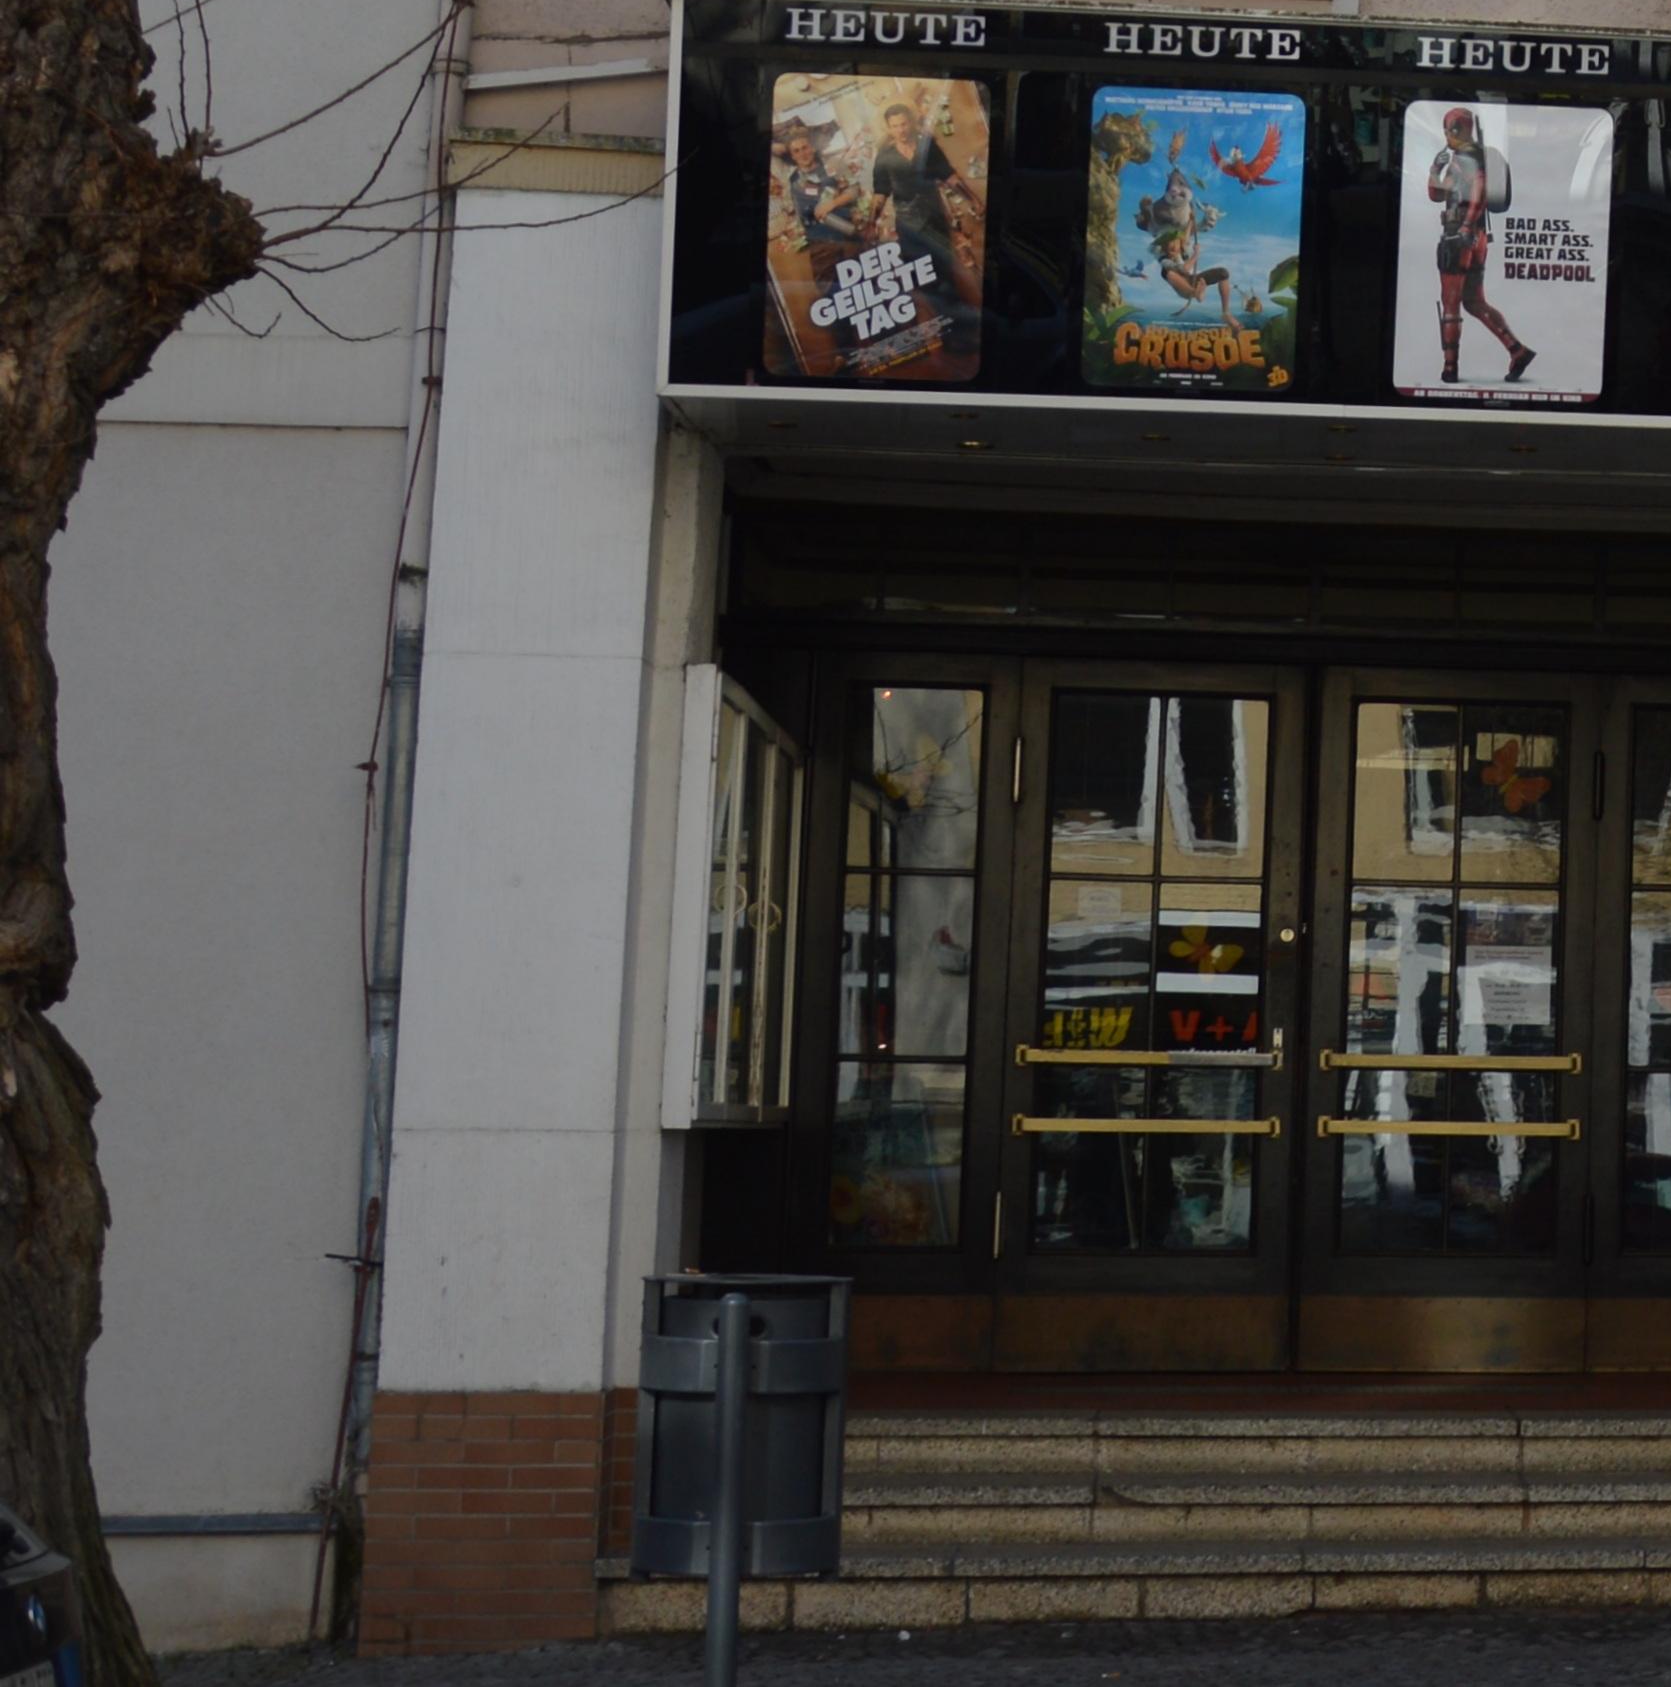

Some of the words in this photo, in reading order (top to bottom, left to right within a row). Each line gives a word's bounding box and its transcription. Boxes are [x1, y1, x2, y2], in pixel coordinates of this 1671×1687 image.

[785, 8, 986, 47] HEUTE
[1103, 22, 1301, 60] HEUTE
[1416, 36, 1610, 75] HEUTE
[1505, 217, 1536, 231] BAD
[1542, 219, 1574, 232] ASS.
[1505, 232, 1557, 246] SMART
[1561, 234, 1594, 248] ASS.
[835, 241, 904, 289] DER
[1504, 246, 1553, 260] GREAT
[1557, 248, 1590, 262] ASS.
[1504, 262, 1595, 282] DEADPOOL
[809, 253, 938, 327] GEILSTE
[850, 294, 917, 341] TAG
[1113, 322, 1266, 372] CRUSOE
